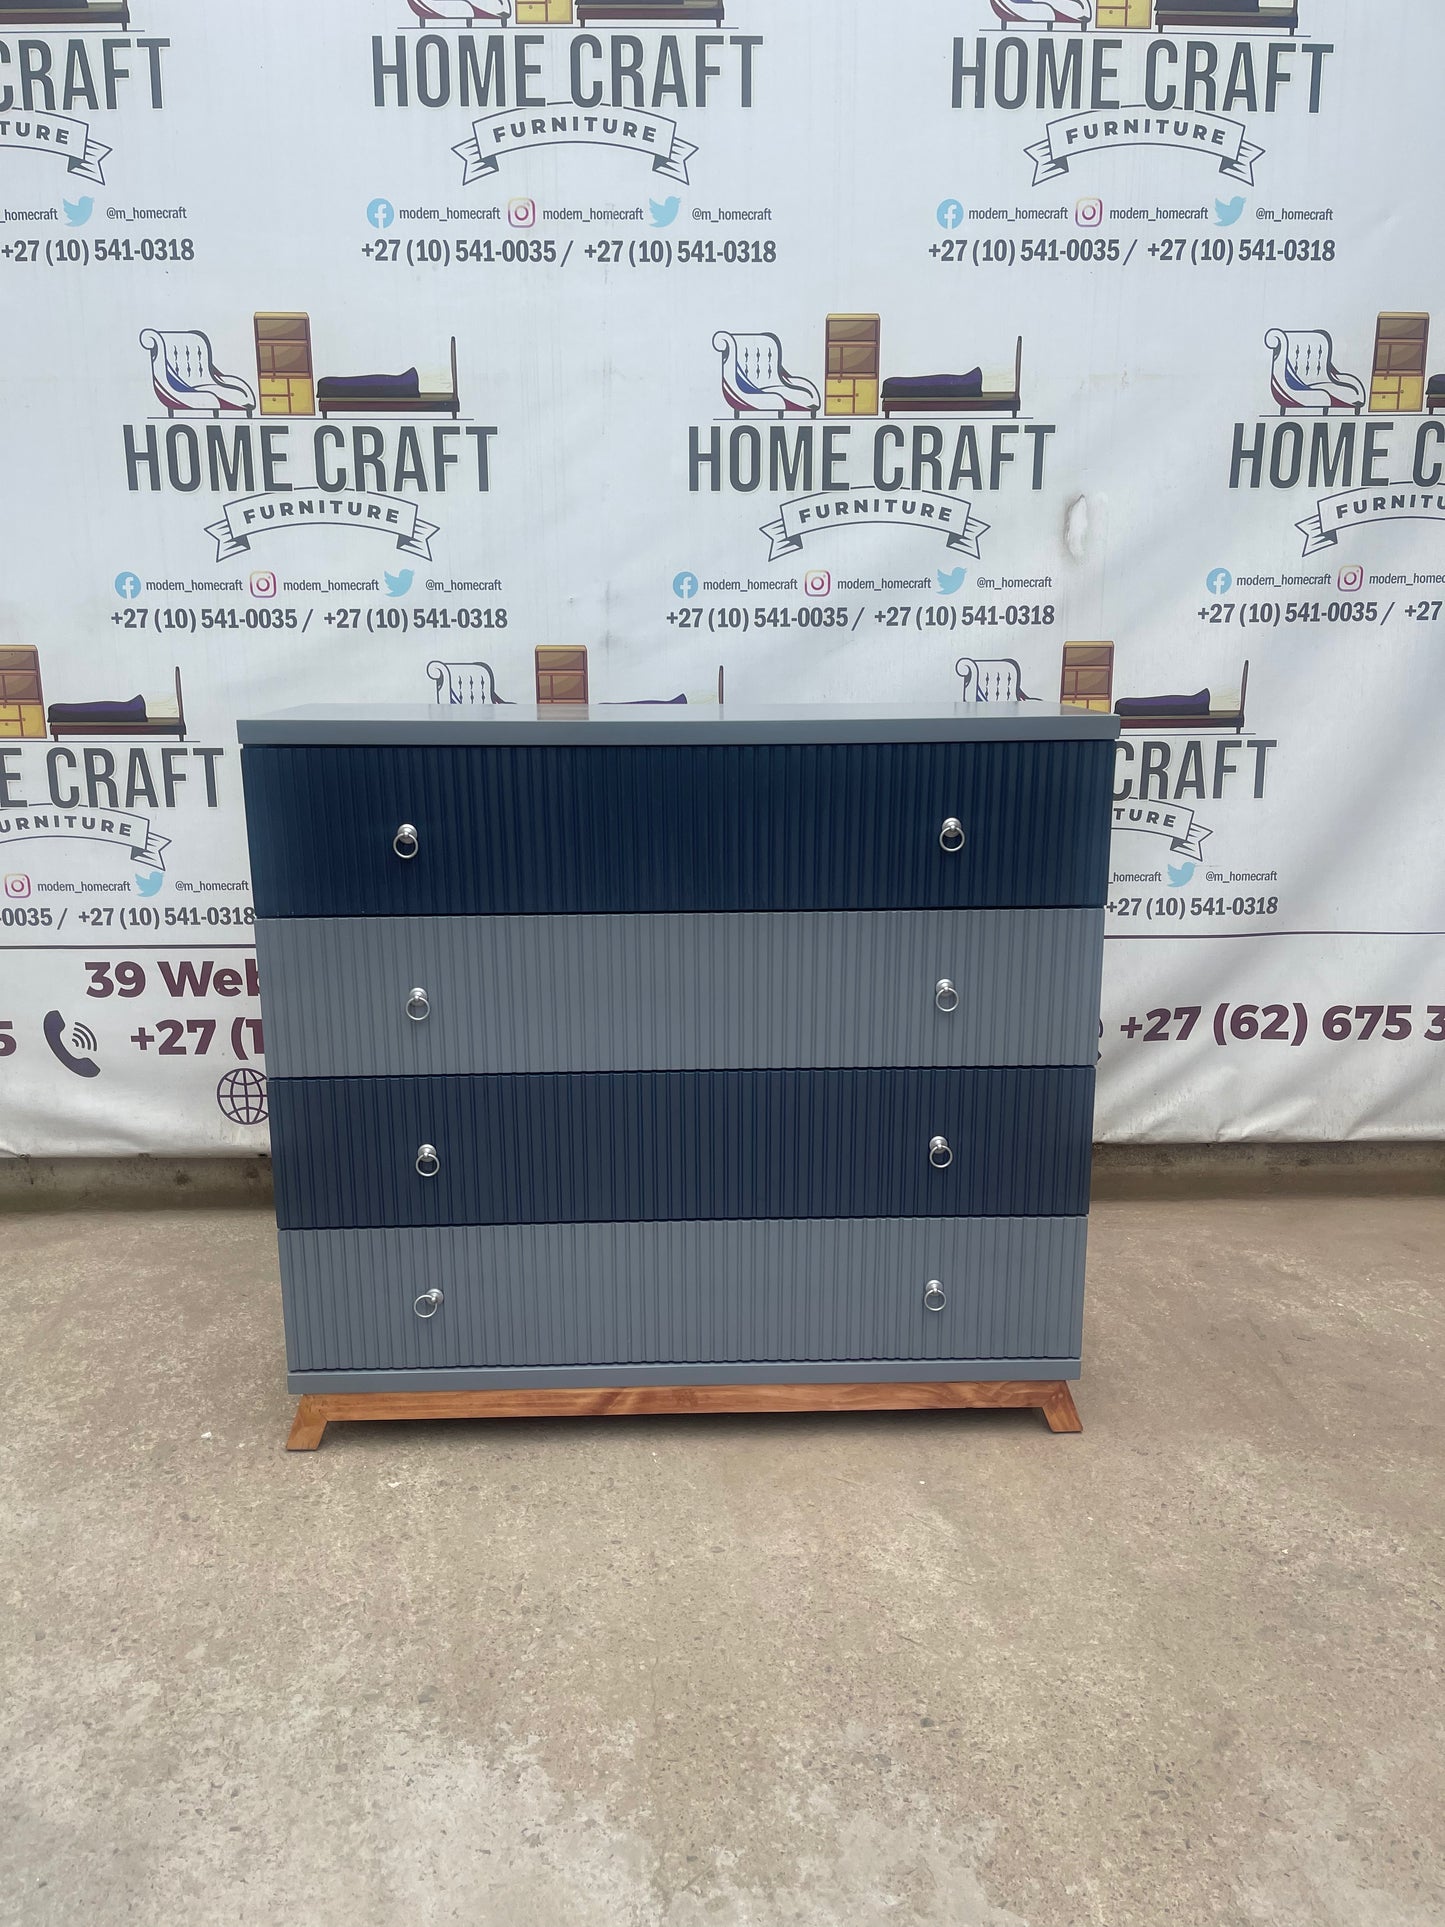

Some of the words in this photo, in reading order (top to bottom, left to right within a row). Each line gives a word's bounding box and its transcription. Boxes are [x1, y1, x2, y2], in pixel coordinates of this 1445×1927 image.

[372, 35, 545, 107] HOME
[570, 34, 763, 108] CRAFT
[952, 37, 1122, 109] HOME
[1145, 40, 1334, 113] CRAFT
[492, 116, 658, 143] FURNITURE
[1065, 119, 1226, 145] FURNITURE
[107, 207, 187, 221] @m_homecraft
[692, 208, 771, 222] @m_homecraft
[1256, 208, 1333, 222] @m_homecraft
[2, 240, 39, 261] +27
[46, 240, 89, 266] (10)
[95, 239, 194, 261] 541-0318
[362, 239, 400, 261] +27
[407, 240, 450, 266] (10)
[585, 240, 623, 262] +27
[629, 241, 672, 267] (10)
[678, 241, 776, 262] 541-0318
[929, 240, 967, 261] +27
[973, 239, 1015, 266] (10)
[1148, 239, 1186, 260] +27
[1191, 239, 1233, 265] (10)
[1239, 239, 1335, 261] 541-0318
[123, 424, 292, 492] HOME
[314, 425, 497, 492] CRAFT
[689, 425, 850, 492] HOME
[874, 425, 1055, 491] CRAFT
[1229, 422, 1393, 488] HOME
[243, 500, 399, 524] FURNITURE
[799, 499, 953, 523] FURNITURE
[426, 579, 502, 592] @m_homecraft
[977, 576, 1052, 590] @m_homecraft
[111, 609, 148, 628] +27
[155, 609, 196, 633] (10)
[324, 609, 360, 628] +27
[367, 609, 408, 632] (10)
[414, 608, 507, 628] 541-0318
[667, 608, 703, 627] +27
[709, 608, 749, 632] (10)
[875, 607, 911, 626] +27
[916, 606, 956, 630] (10)
[962, 605, 1054, 625] 541-0318
[1198, 604, 1235, 623] +27
[1240, 603, 1280, 627] (10)
[1405, 601, 1442, 620] +27
[47, 747, 224, 808] CRAFT
[176, 881, 249, 892] @m_homecraft
[1206, 871, 1277, 883] @m_homecraft
[79, 908, 113, 925] +27
[120, 908, 159, 930] (10)
[1106, 898, 1141, 915] +27
[1147, 898, 1185, 919] (10)
[1191, 897, 1278, 915] 541-0318
[85, 961, 145, 998] 39
[131, 1020, 216, 1055] +27
[1120, 1006, 1201, 1041] +27
[1214, 1003, 1307, 1046] (62)
[1322, 1005, 1411, 1040] 675
